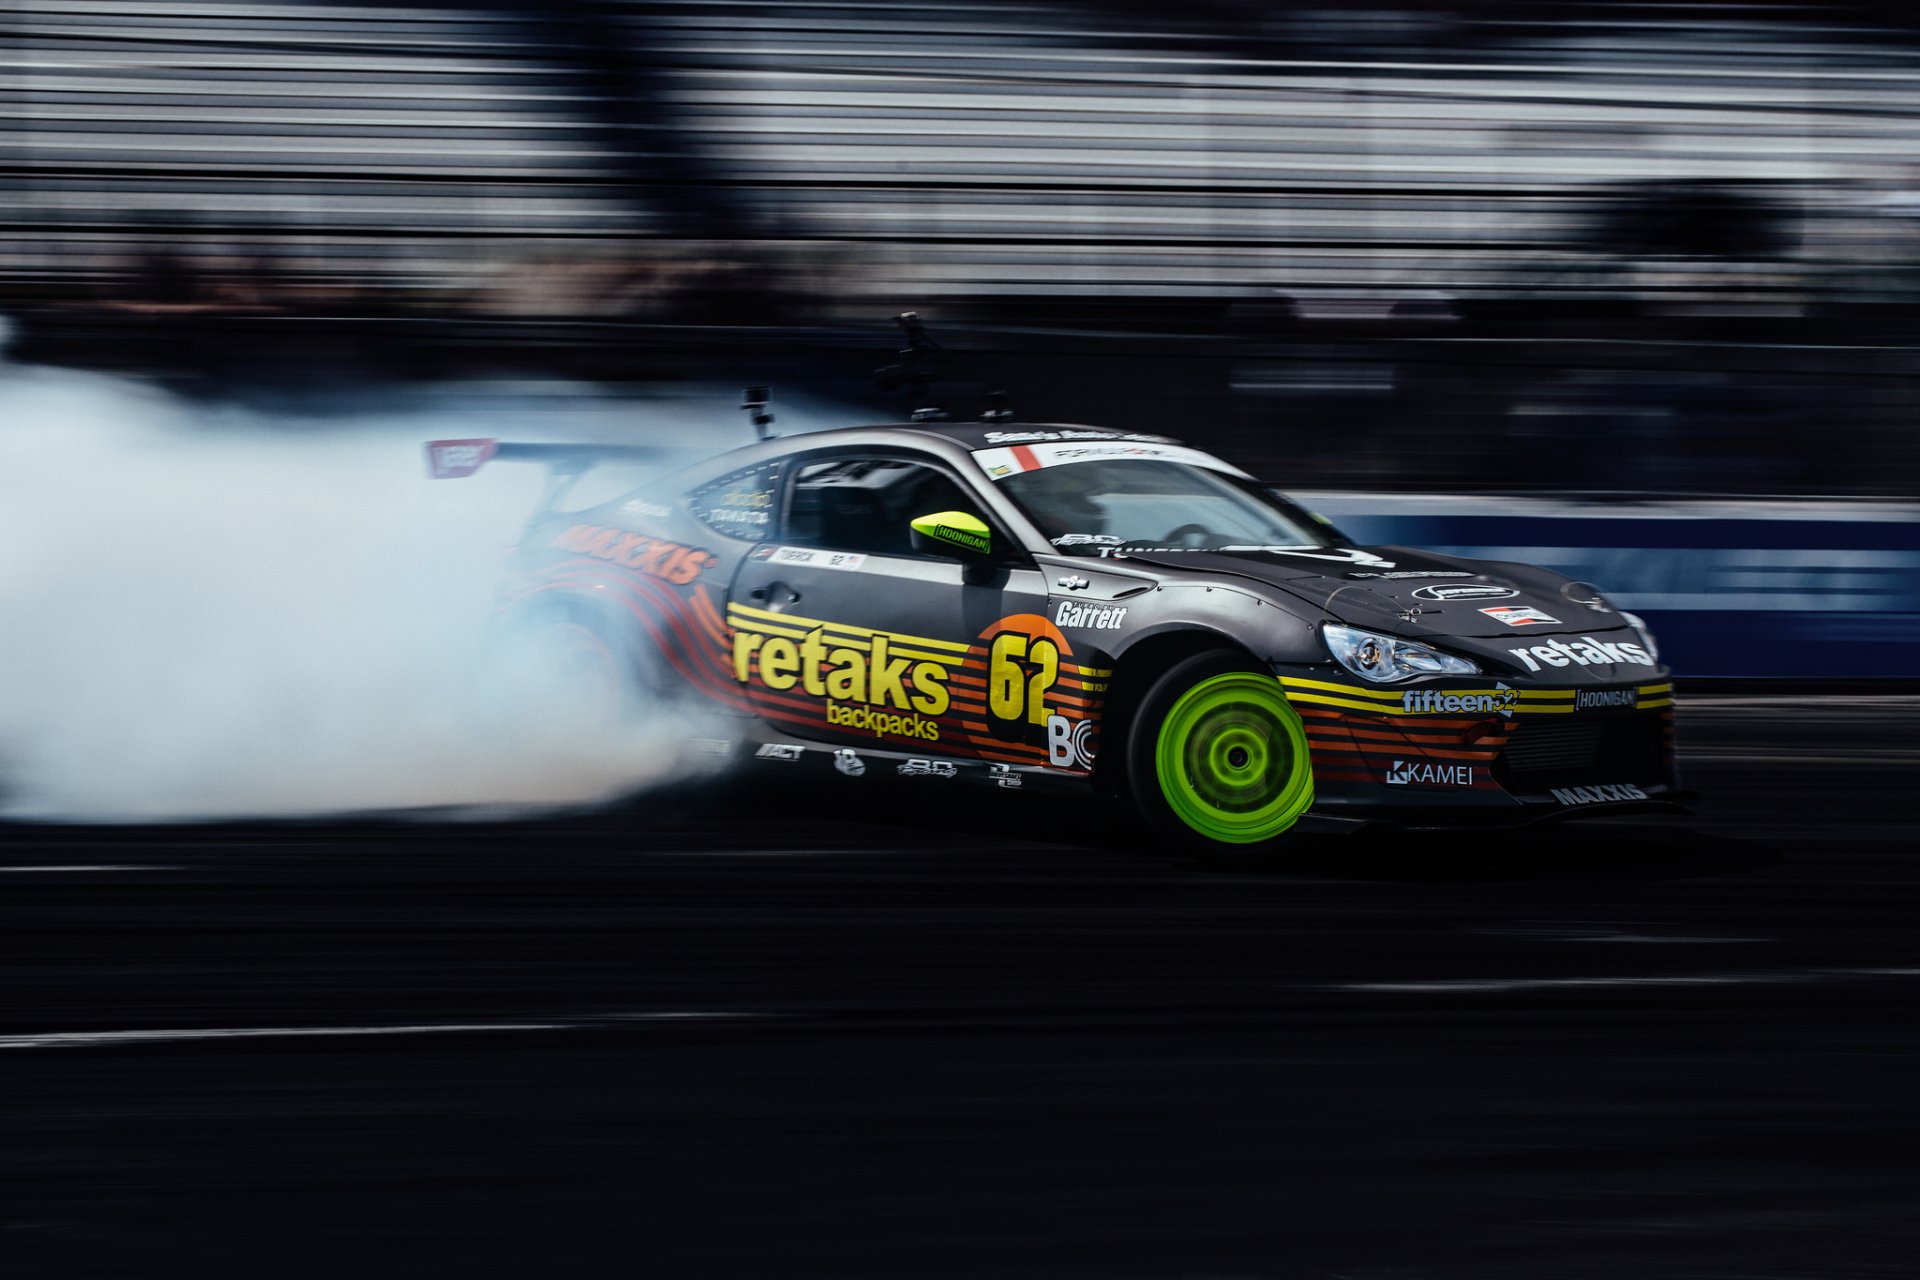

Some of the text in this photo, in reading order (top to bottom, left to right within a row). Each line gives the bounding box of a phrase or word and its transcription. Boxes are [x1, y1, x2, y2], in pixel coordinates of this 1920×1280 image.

[1055, 601, 1128, 629] Garrett
[733, 624, 950, 716] retaks
[1508, 636, 1655, 672] retaks
[989, 634, 1058, 728] 62
[827, 699, 939, 741] backpacks
[1407, 763, 1472, 785] KAMEI
[1551, 783, 1649, 806] MAXXIS
